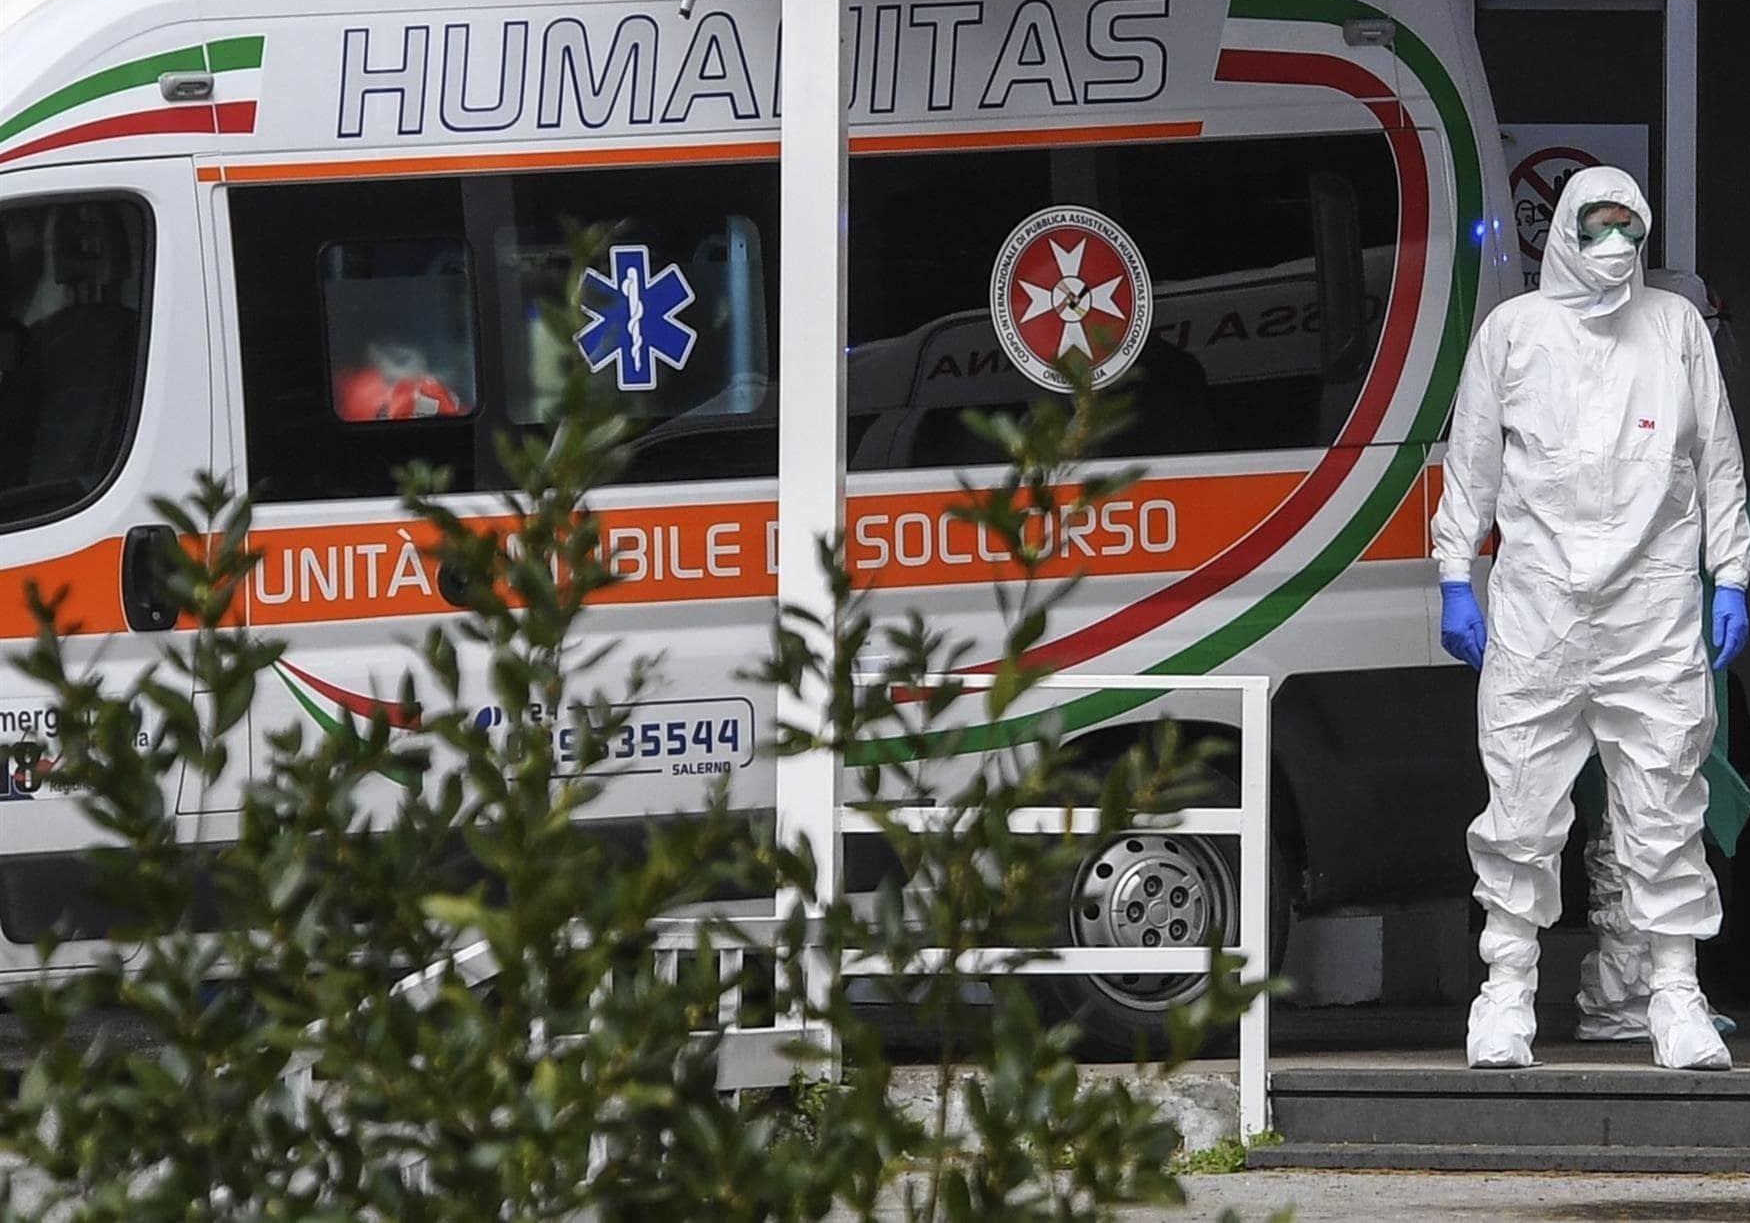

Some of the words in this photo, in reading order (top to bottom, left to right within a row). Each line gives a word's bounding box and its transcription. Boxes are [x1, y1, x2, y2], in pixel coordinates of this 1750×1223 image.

[1017, 233, 1027, 246] DI
[1026, 213, 1067, 238] PUBBLICA
[1068, 214, 1120, 244] ASSISTENZA
[1118, 241, 1146, 302] HUMANITAS
[996, 245, 1018, 333] INTERNAZIONALE
[1122, 303, 1145, 356] SOCCORSO
[1006, 333, 1029, 364] CORPO
[1638, 418, 1655, 430] 3M
[255, 529, 432, 605] UNITÀ
[672, 761, 732, 776] SALERNO
